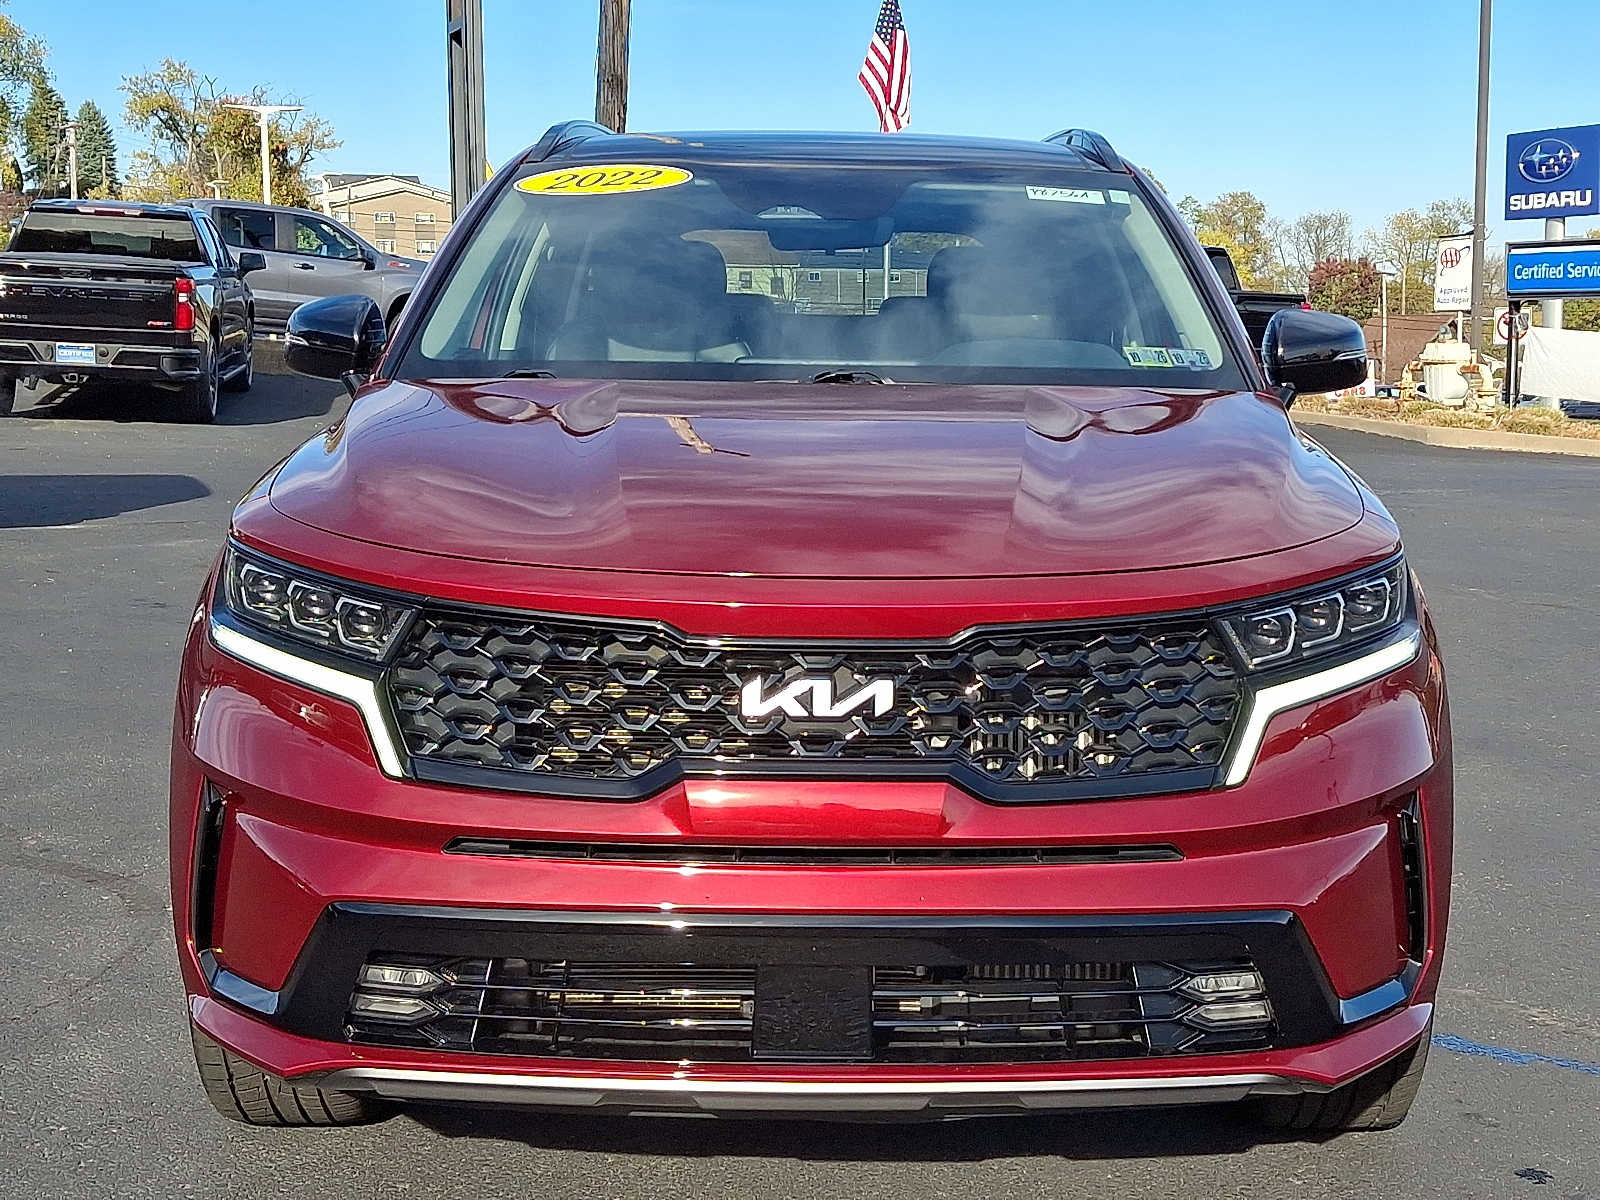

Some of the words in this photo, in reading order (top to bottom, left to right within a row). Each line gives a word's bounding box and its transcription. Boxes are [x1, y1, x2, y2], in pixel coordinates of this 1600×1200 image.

[545, 170, 663, 190] 2022
[1509, 189, 1593, 211] SUBARU
[1514, 263, 1564, 281] Certified
[741, 674, 895, 718] KIA
